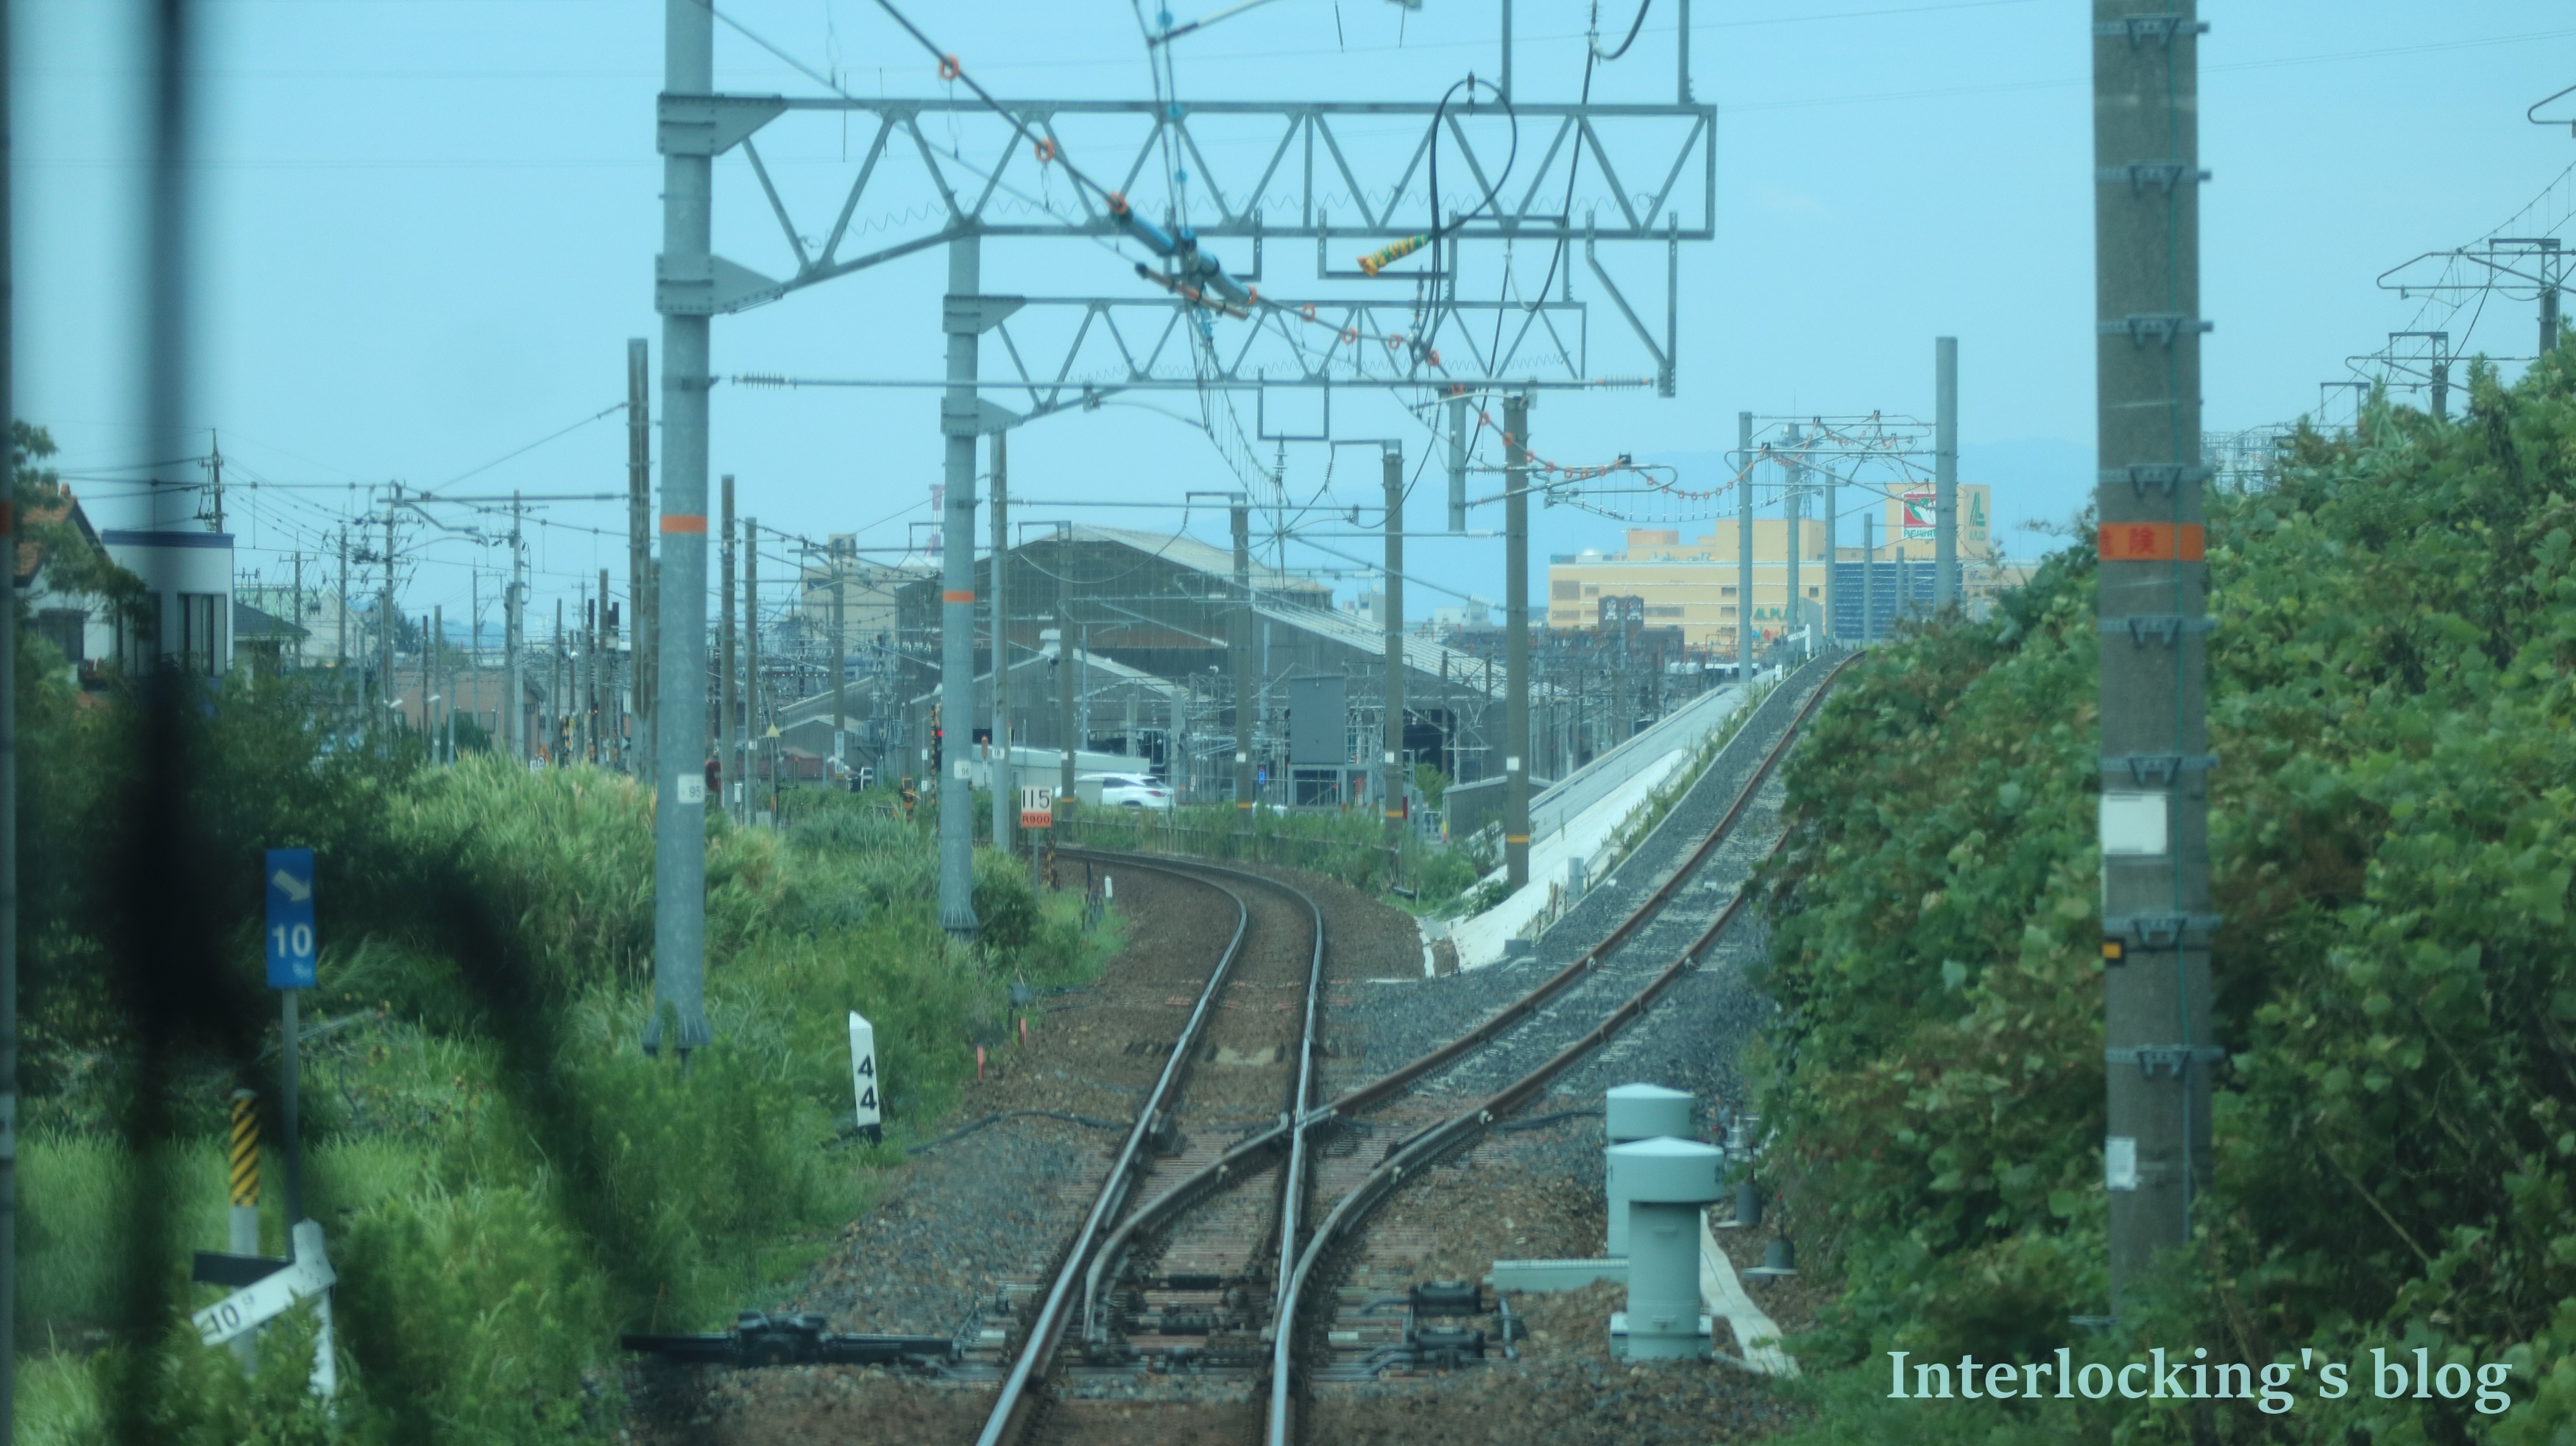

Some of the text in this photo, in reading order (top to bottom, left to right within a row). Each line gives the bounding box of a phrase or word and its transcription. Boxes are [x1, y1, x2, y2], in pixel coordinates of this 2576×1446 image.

[1022, 790, 1050, 809] 115
[1022, 815, 1050, 823] R900
[272, 924, 313, 957] 10
[210, 1303, 241, 1333] 10
